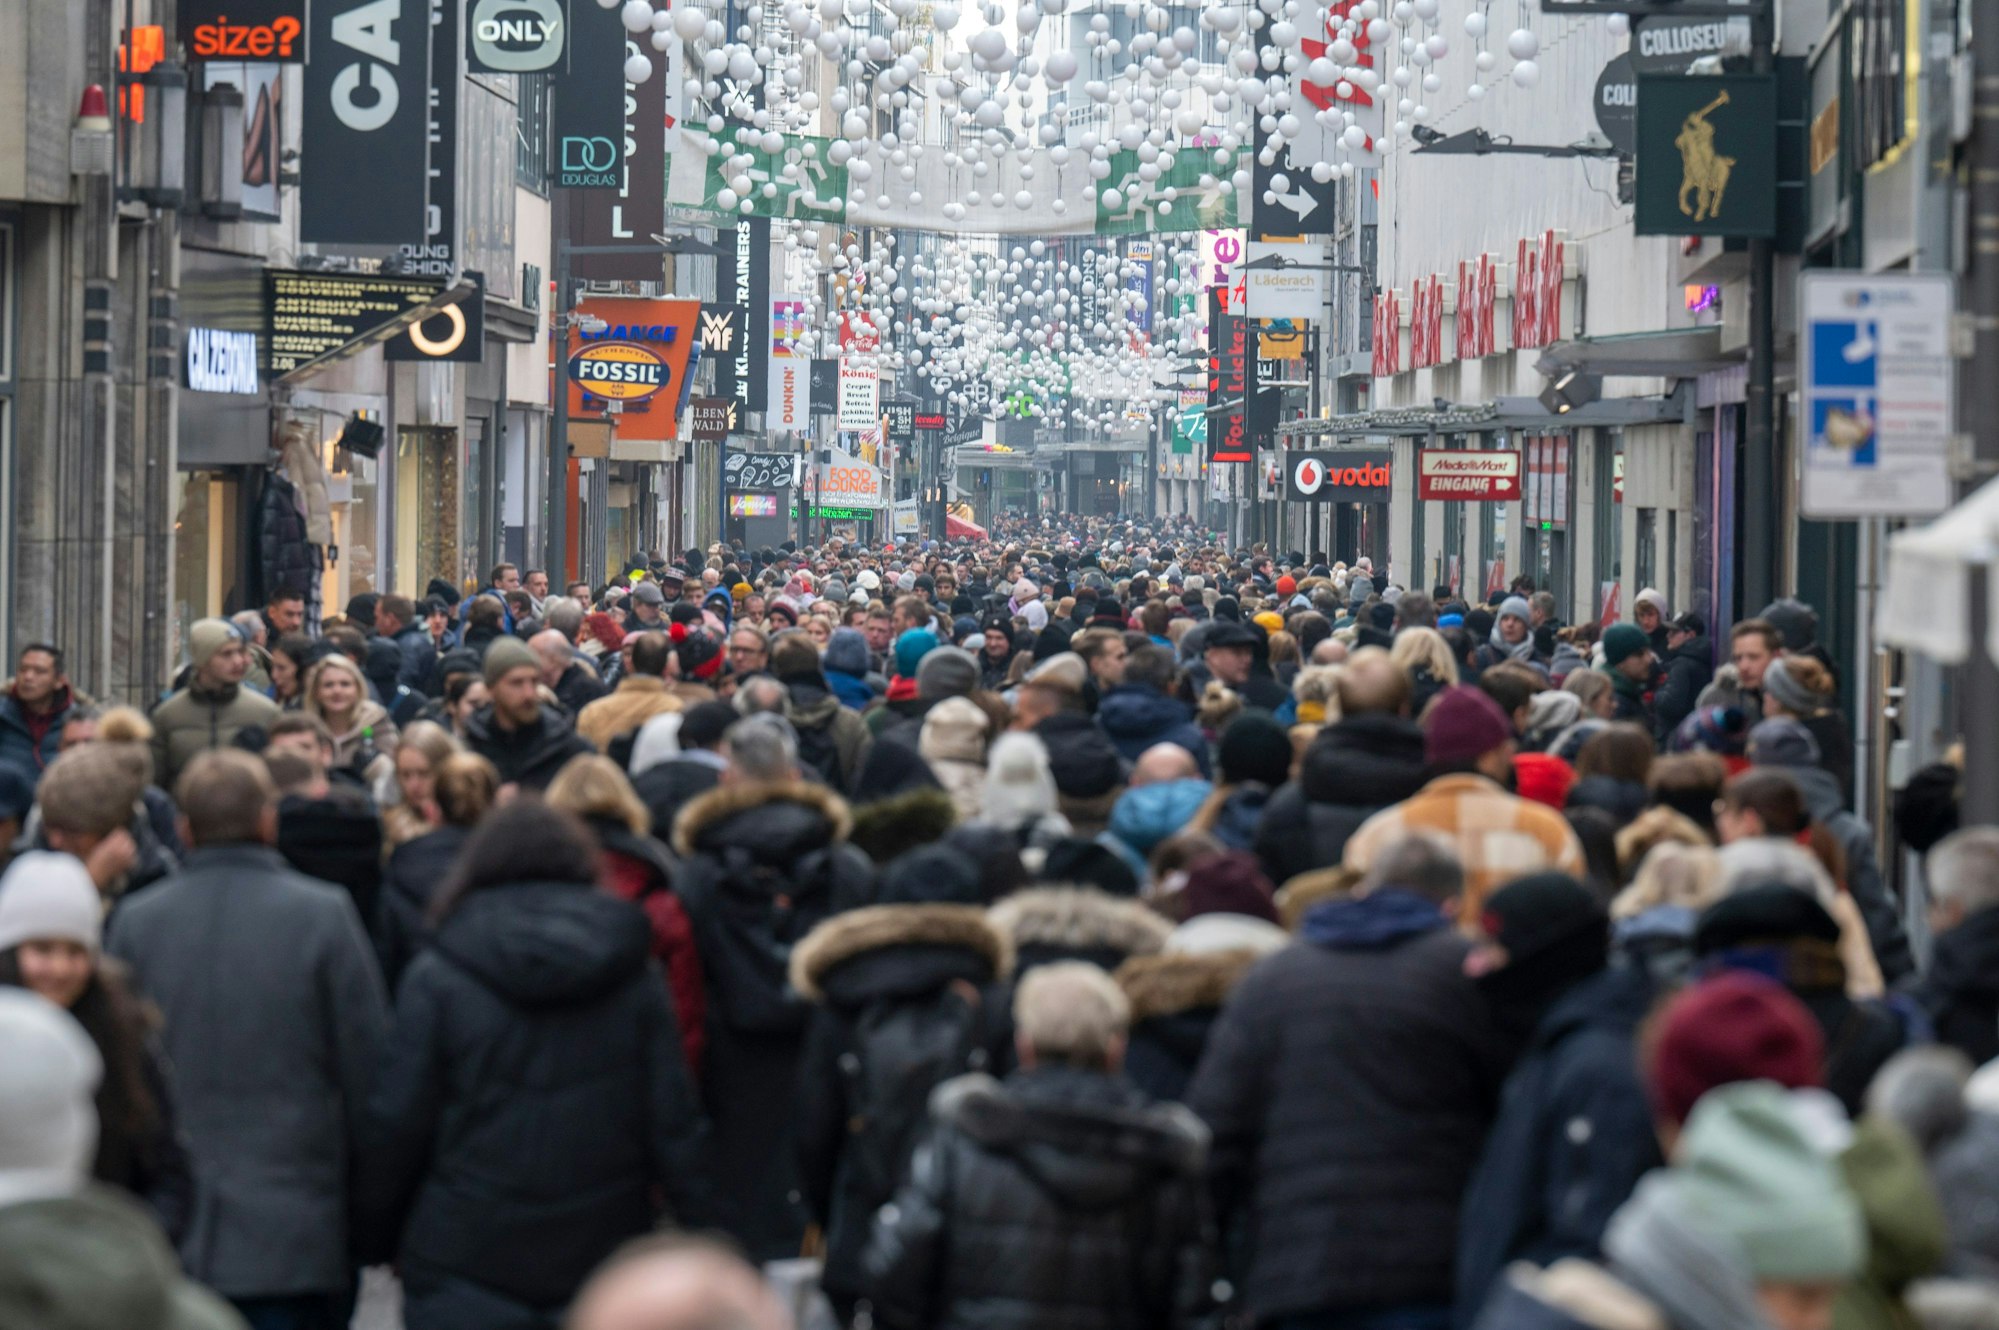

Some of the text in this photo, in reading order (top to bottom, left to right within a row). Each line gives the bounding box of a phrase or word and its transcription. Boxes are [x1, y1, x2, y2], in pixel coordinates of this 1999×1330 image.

[193, 15, 301, 57] size?
[477, 19, 558, 41] ONLY
[562, 174, 616, 185] DOUGLAS
[400, 244, 449, 259] OUNG
[1254, 274, 1315, 286] Läderach
[701, 310, 734, 351] WMF
[579, 361, 660, 383] FOSSIL
[842, 369, 876, 379] König
[692, 407, 725, 418] LBEN
[751, 456, 774, 467] Candy!
[830, 467, 871, 481] FOOD
[822, 479, 877, 493] LOUNGE
[1429, 477, 1490, 492] EINGANG
